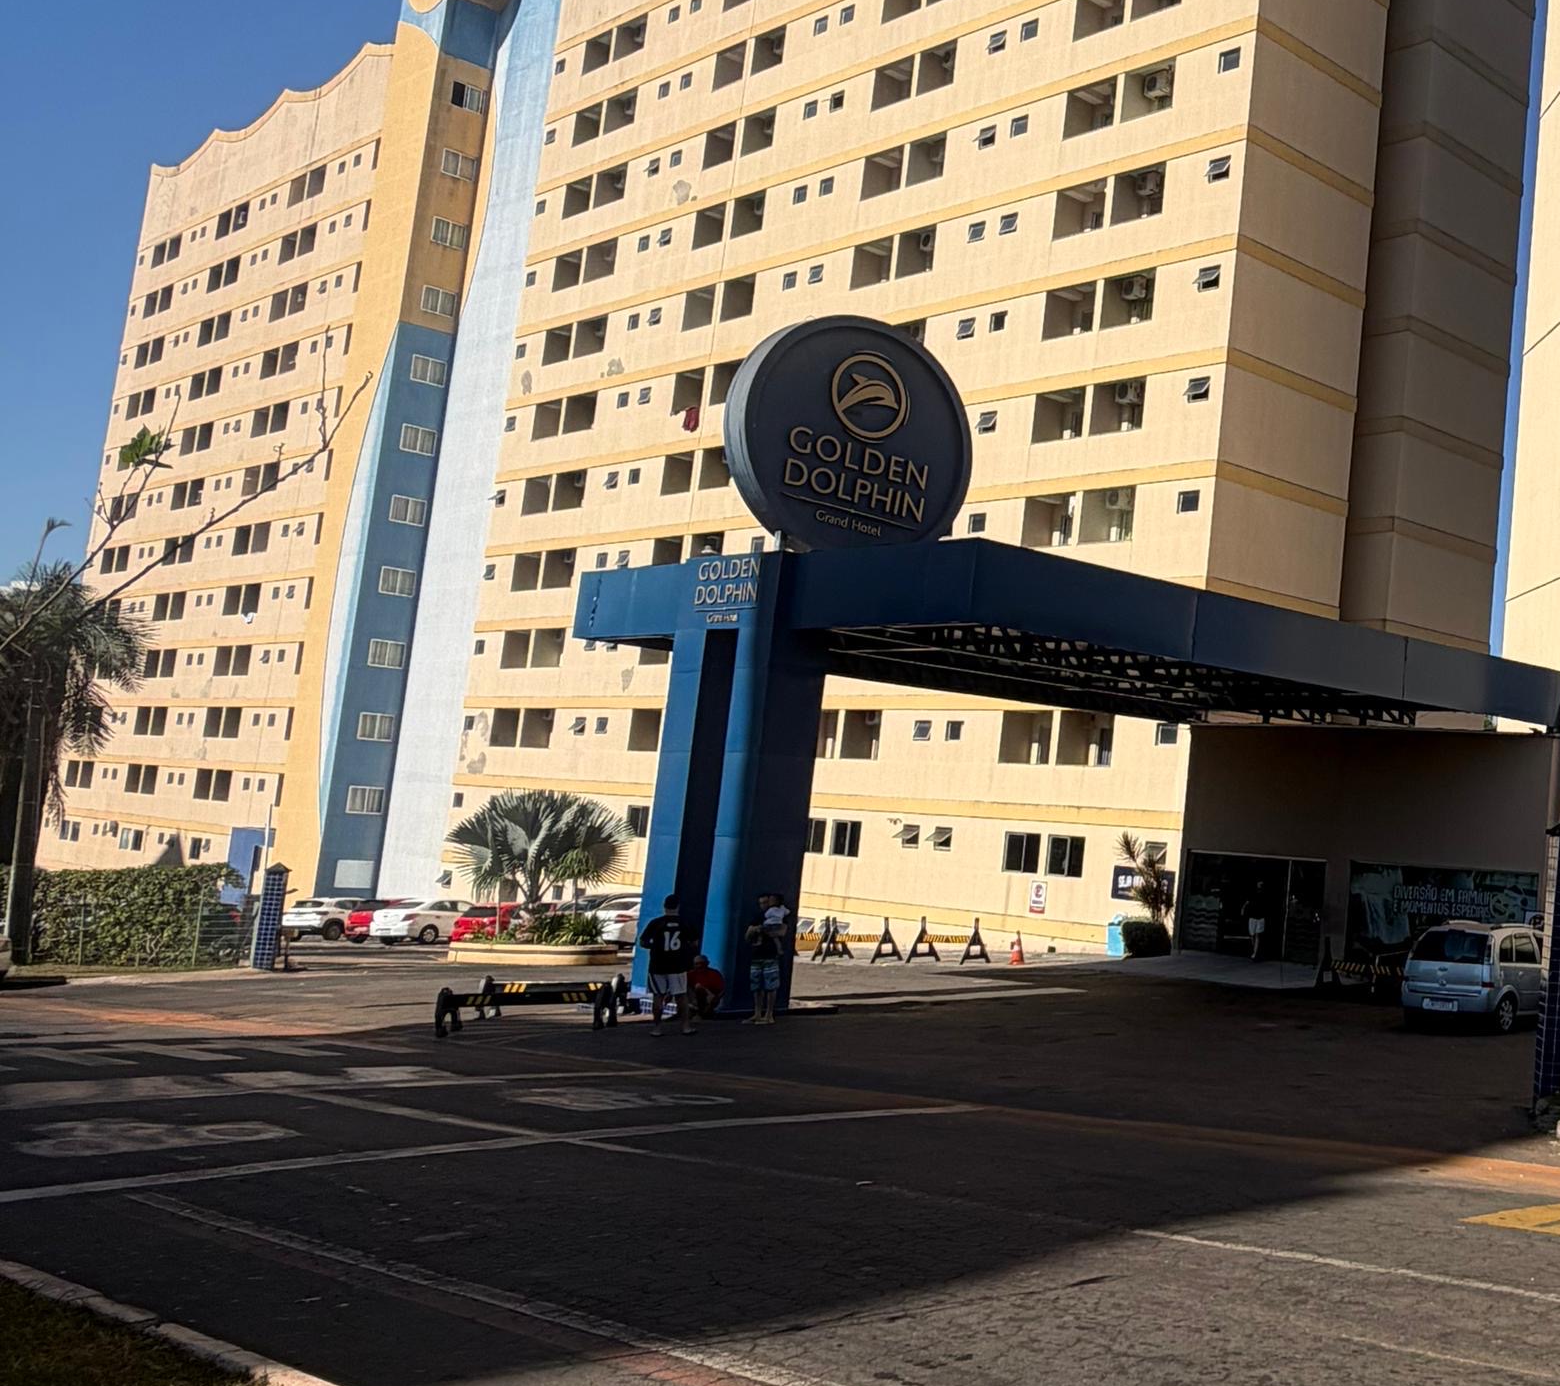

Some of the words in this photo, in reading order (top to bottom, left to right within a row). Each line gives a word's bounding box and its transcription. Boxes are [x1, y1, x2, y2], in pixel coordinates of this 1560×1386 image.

[789, 426, 929, 491] GOLDEN
[783, 457, 925, 523] DOLPHIN
[815, 509, 849, 529] Grand
[851, 519, 882, 537] Hotel
[698, 557, 761, 581] GOLDEN
[694, 581, 758, 605] DOLPHIN
[1393, 884, 1438, 901] DIVERSÃO
[1440, 887, 1455, 903] EM
[1400, 900, 1450, 916] MOMENTOS
[1451, 903, 1491, 918] ESPECIAIS
[663, 930, 681, 952] 16
